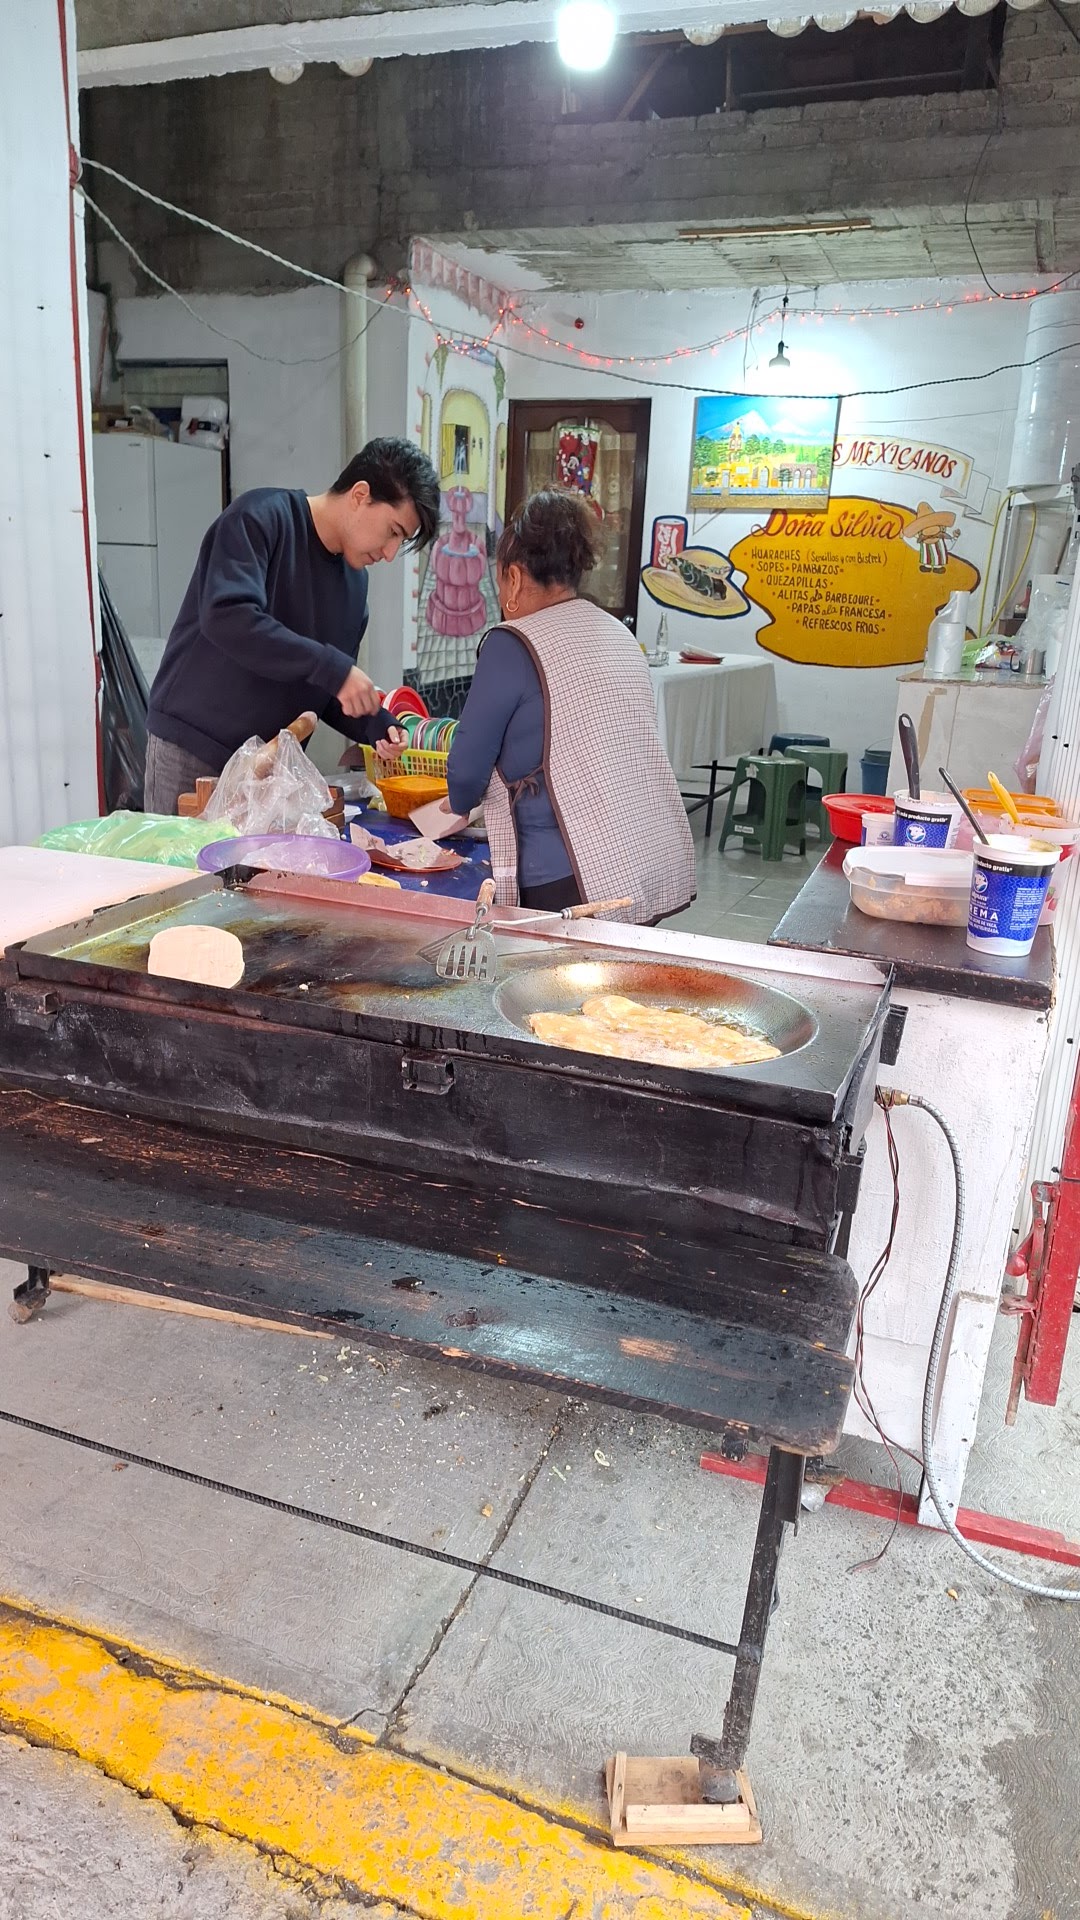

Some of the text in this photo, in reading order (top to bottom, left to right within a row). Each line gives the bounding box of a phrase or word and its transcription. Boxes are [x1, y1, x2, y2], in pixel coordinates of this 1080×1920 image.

[840, 440, 958, 479] MEXICANOS
[751, 505, 904, 539] Doña Silvia
[751, 547, 800, 561] HUARACHES
[756, 562, 840, 575] SOPES PAMBAZOS
[777, 590, 809, 601] ALITAS
[791, 602, 821, 615] PAPAS
[839, 606, 886, 619] FRANCESA
[802, 616, 880, 635] REFRESCOS FRIOS
[908, 814, 931, 823] producto
